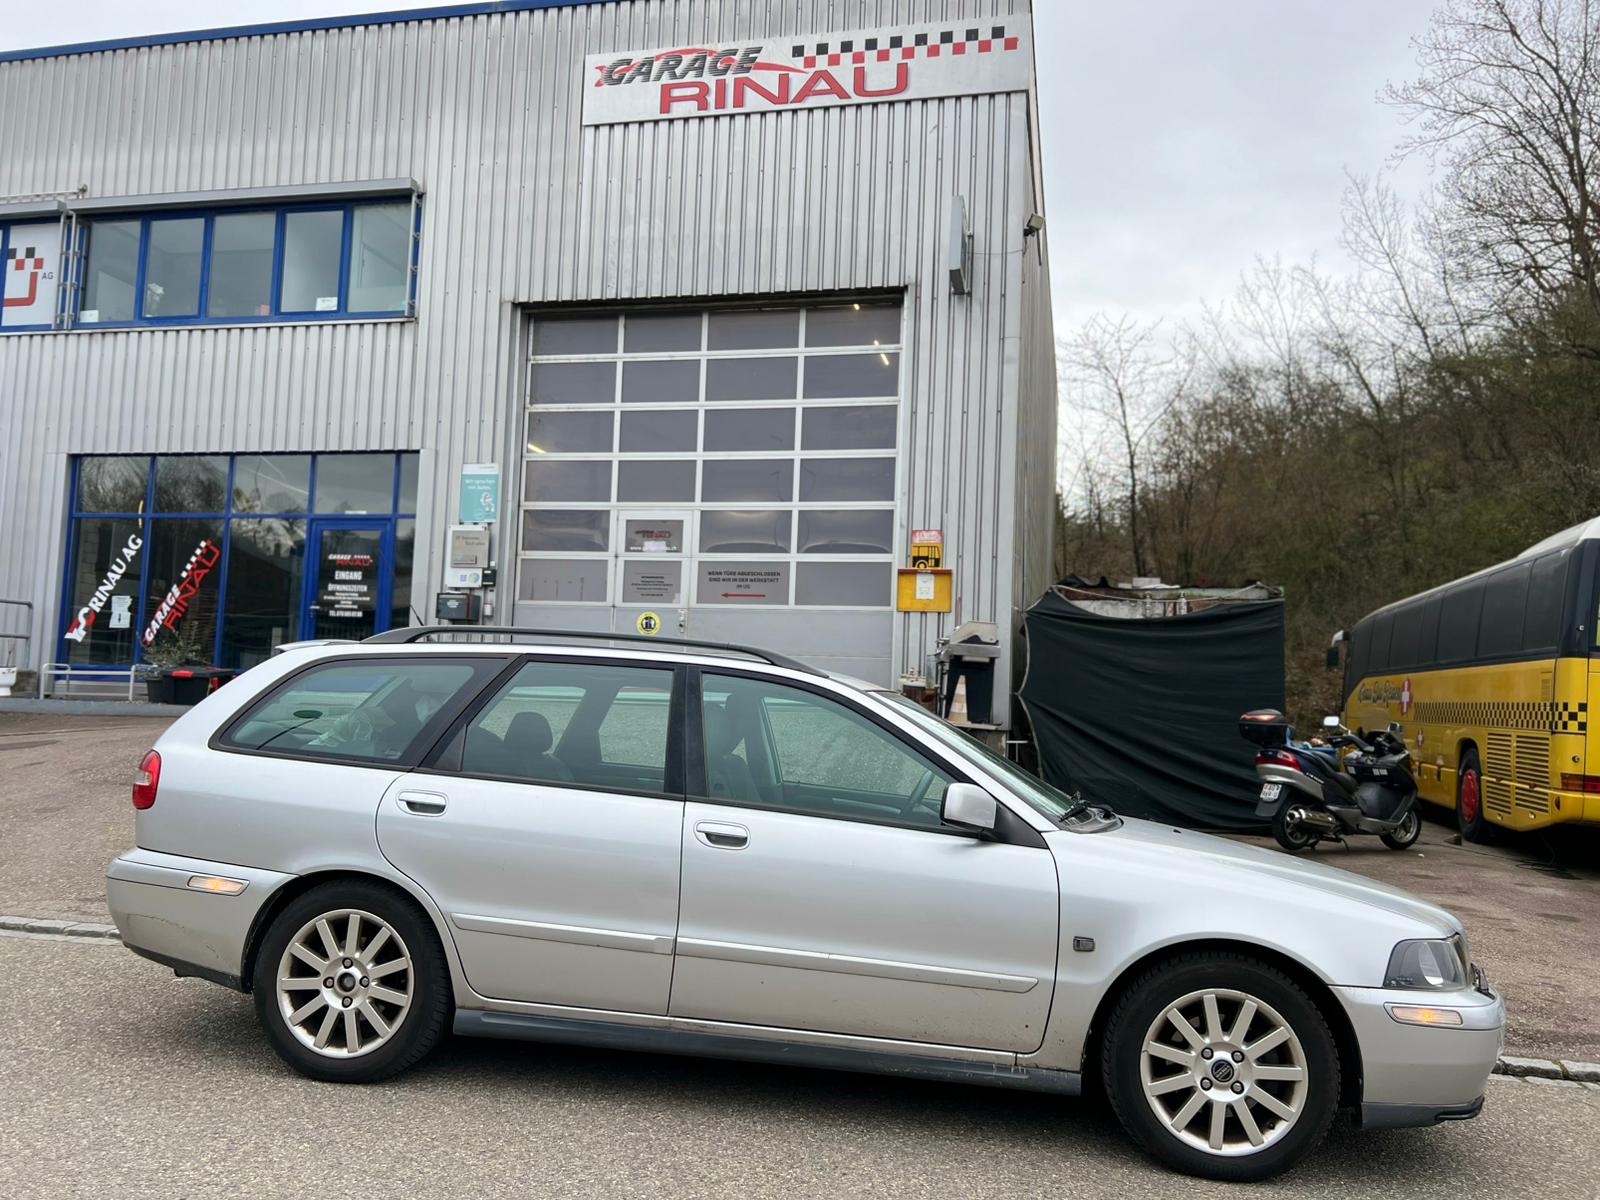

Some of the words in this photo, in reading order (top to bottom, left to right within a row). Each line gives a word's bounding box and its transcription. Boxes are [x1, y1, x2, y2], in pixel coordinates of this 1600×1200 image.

[600, 46, 763, 86] GARAGE
[659, 62, 909, 114] RINAU
[41, 271, 54, 280] AG
[88, 558, 127, 613] RINAU
[122, 534, 143, 562] AG
[163, 545, 221, 633] RINAU
[144, 583, 181, 642] GARAGE
